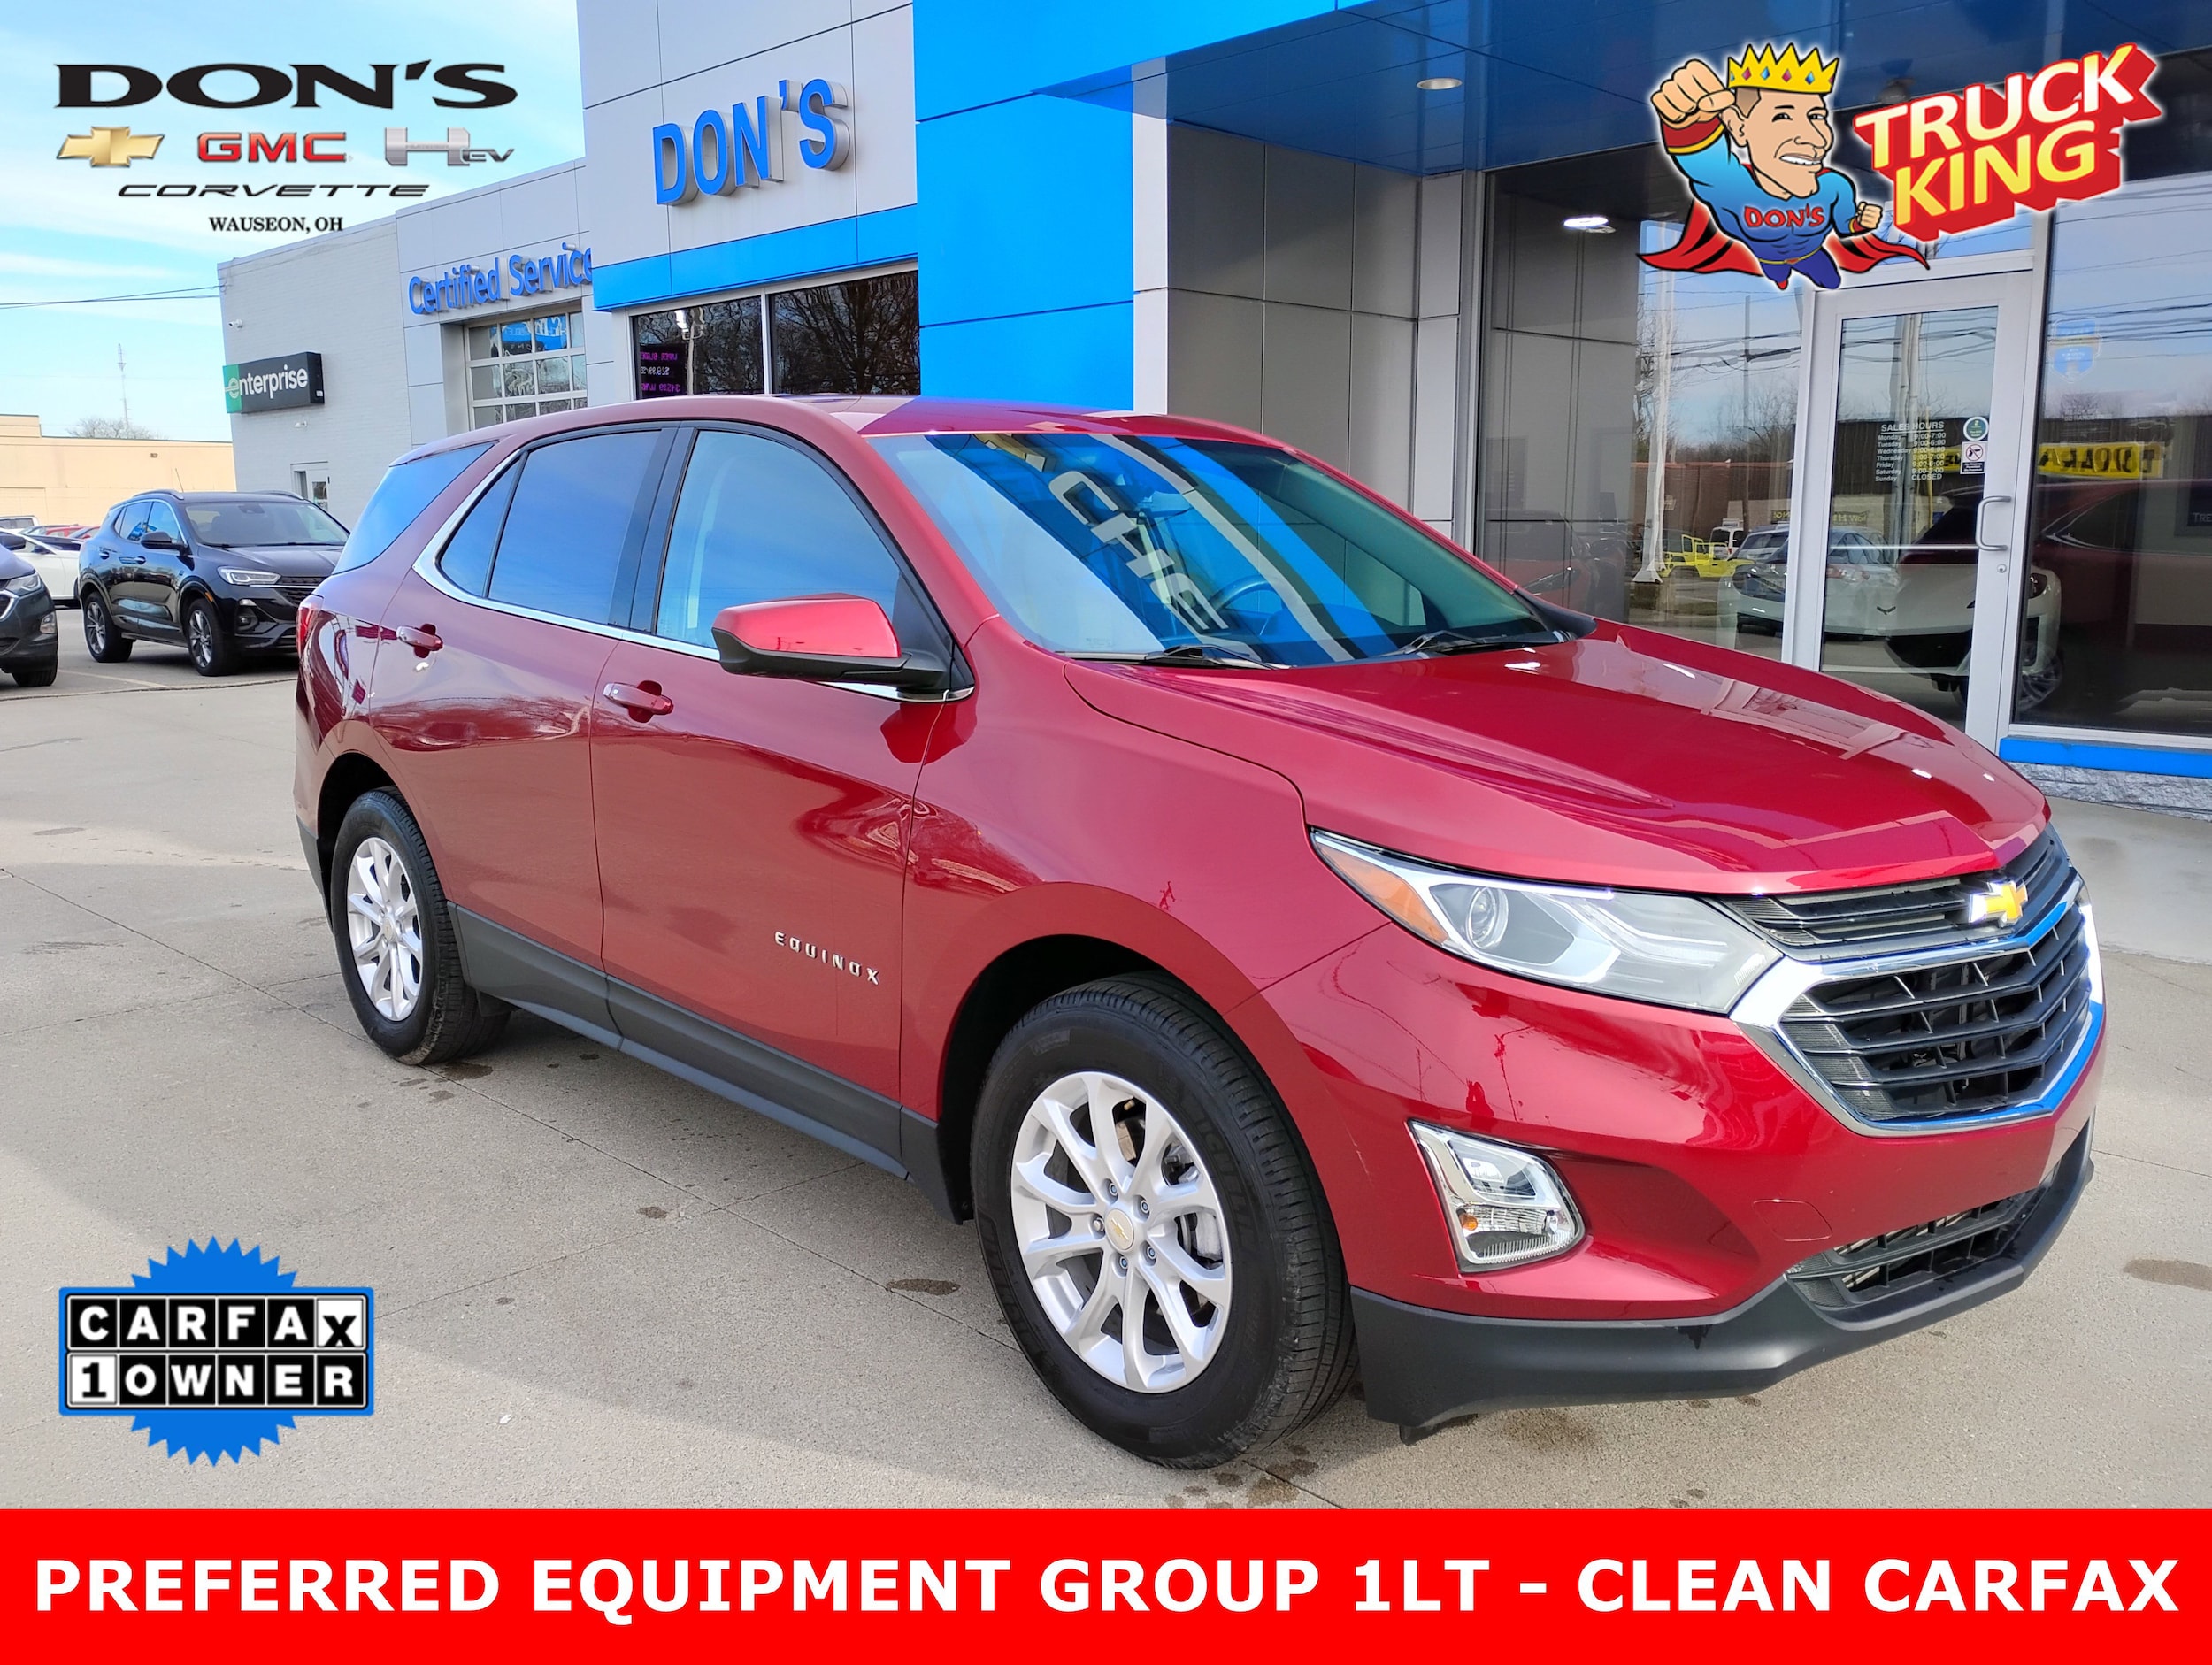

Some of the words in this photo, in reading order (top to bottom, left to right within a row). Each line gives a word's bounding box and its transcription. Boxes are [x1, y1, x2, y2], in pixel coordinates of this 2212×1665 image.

[652, 78, 837, 205] DON'S
[409, 257, 501, 315] Certified
[508, 242, 592, 296] Service
[226, 364, 309, 399] enterprise
[1881, 423, 1909, 432] SALES
[1913, 421, 1945, 430] HOURS
[774, 931, 879, 986] EQUINOX
